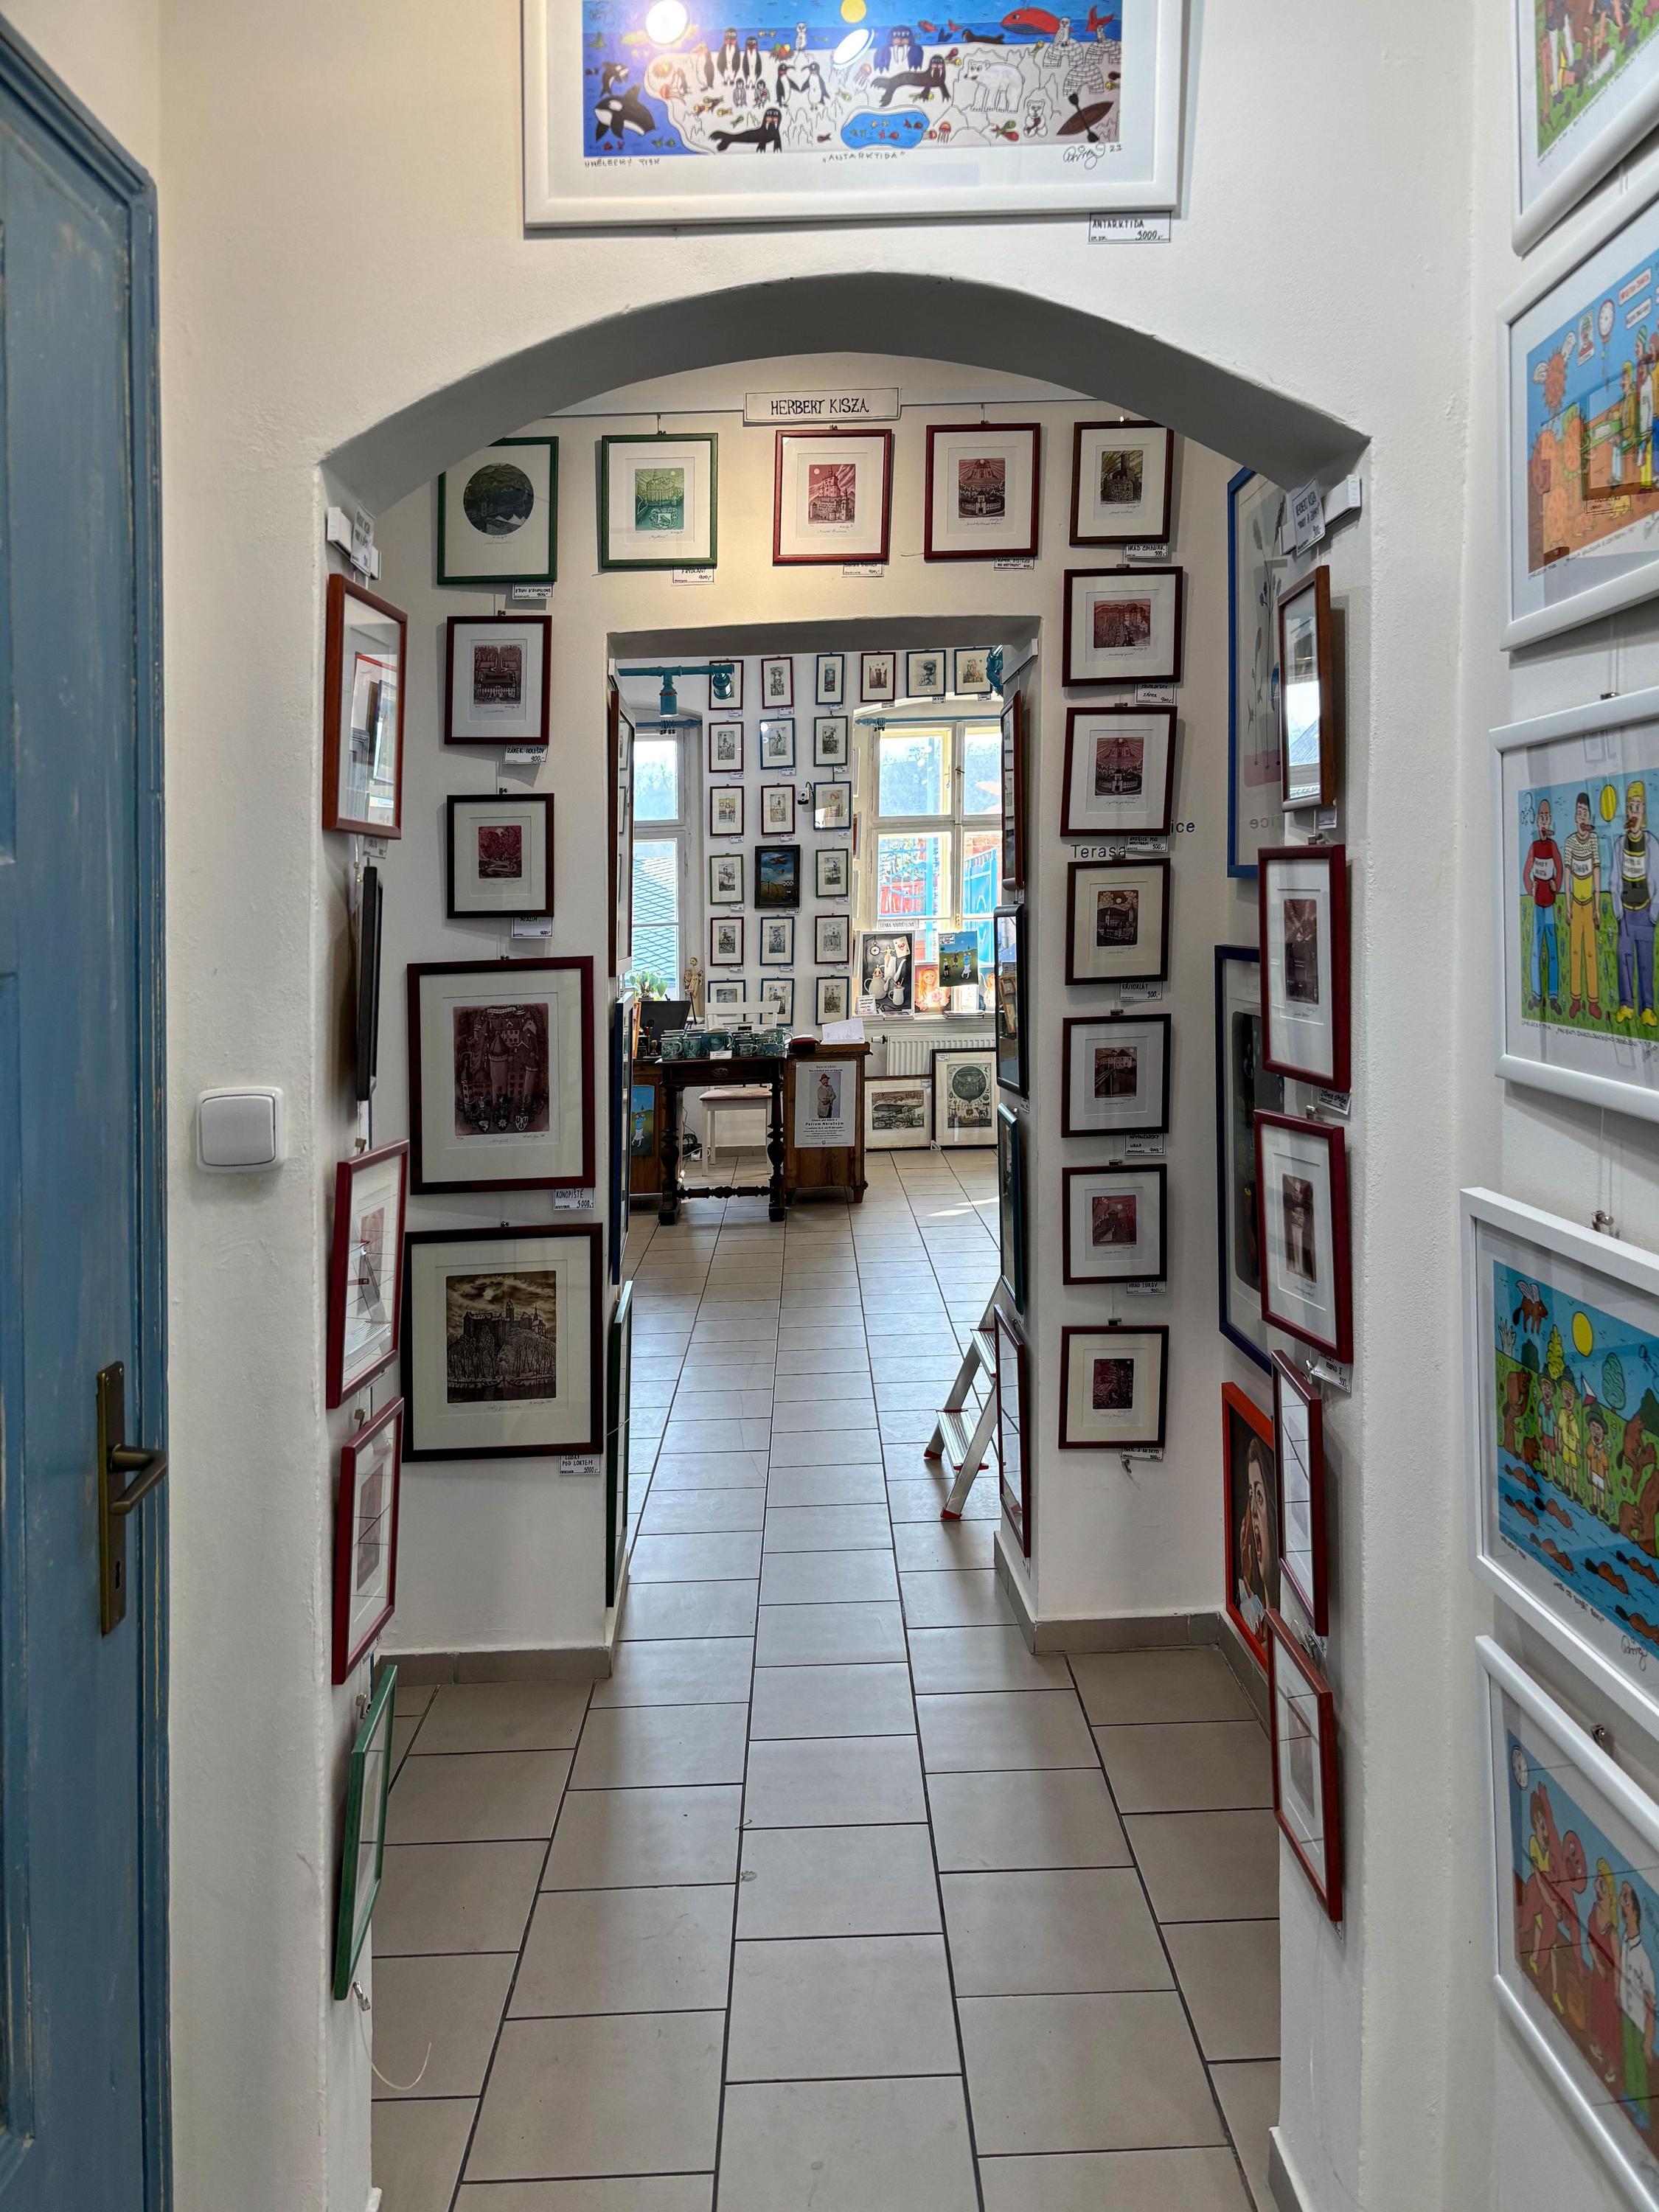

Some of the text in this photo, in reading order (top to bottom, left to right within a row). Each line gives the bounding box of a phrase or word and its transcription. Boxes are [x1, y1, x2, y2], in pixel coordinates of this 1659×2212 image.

[1093, 219, 1144, 229] ANTARKTIDA
[771, 398, 869, 415] HERBERT KISZA
[1171, 820, 1195, 832] ice
[1071, 845, 1126, 858] Terasa
[556, 1188, 584, 1198] KONOPIŠTĚ
